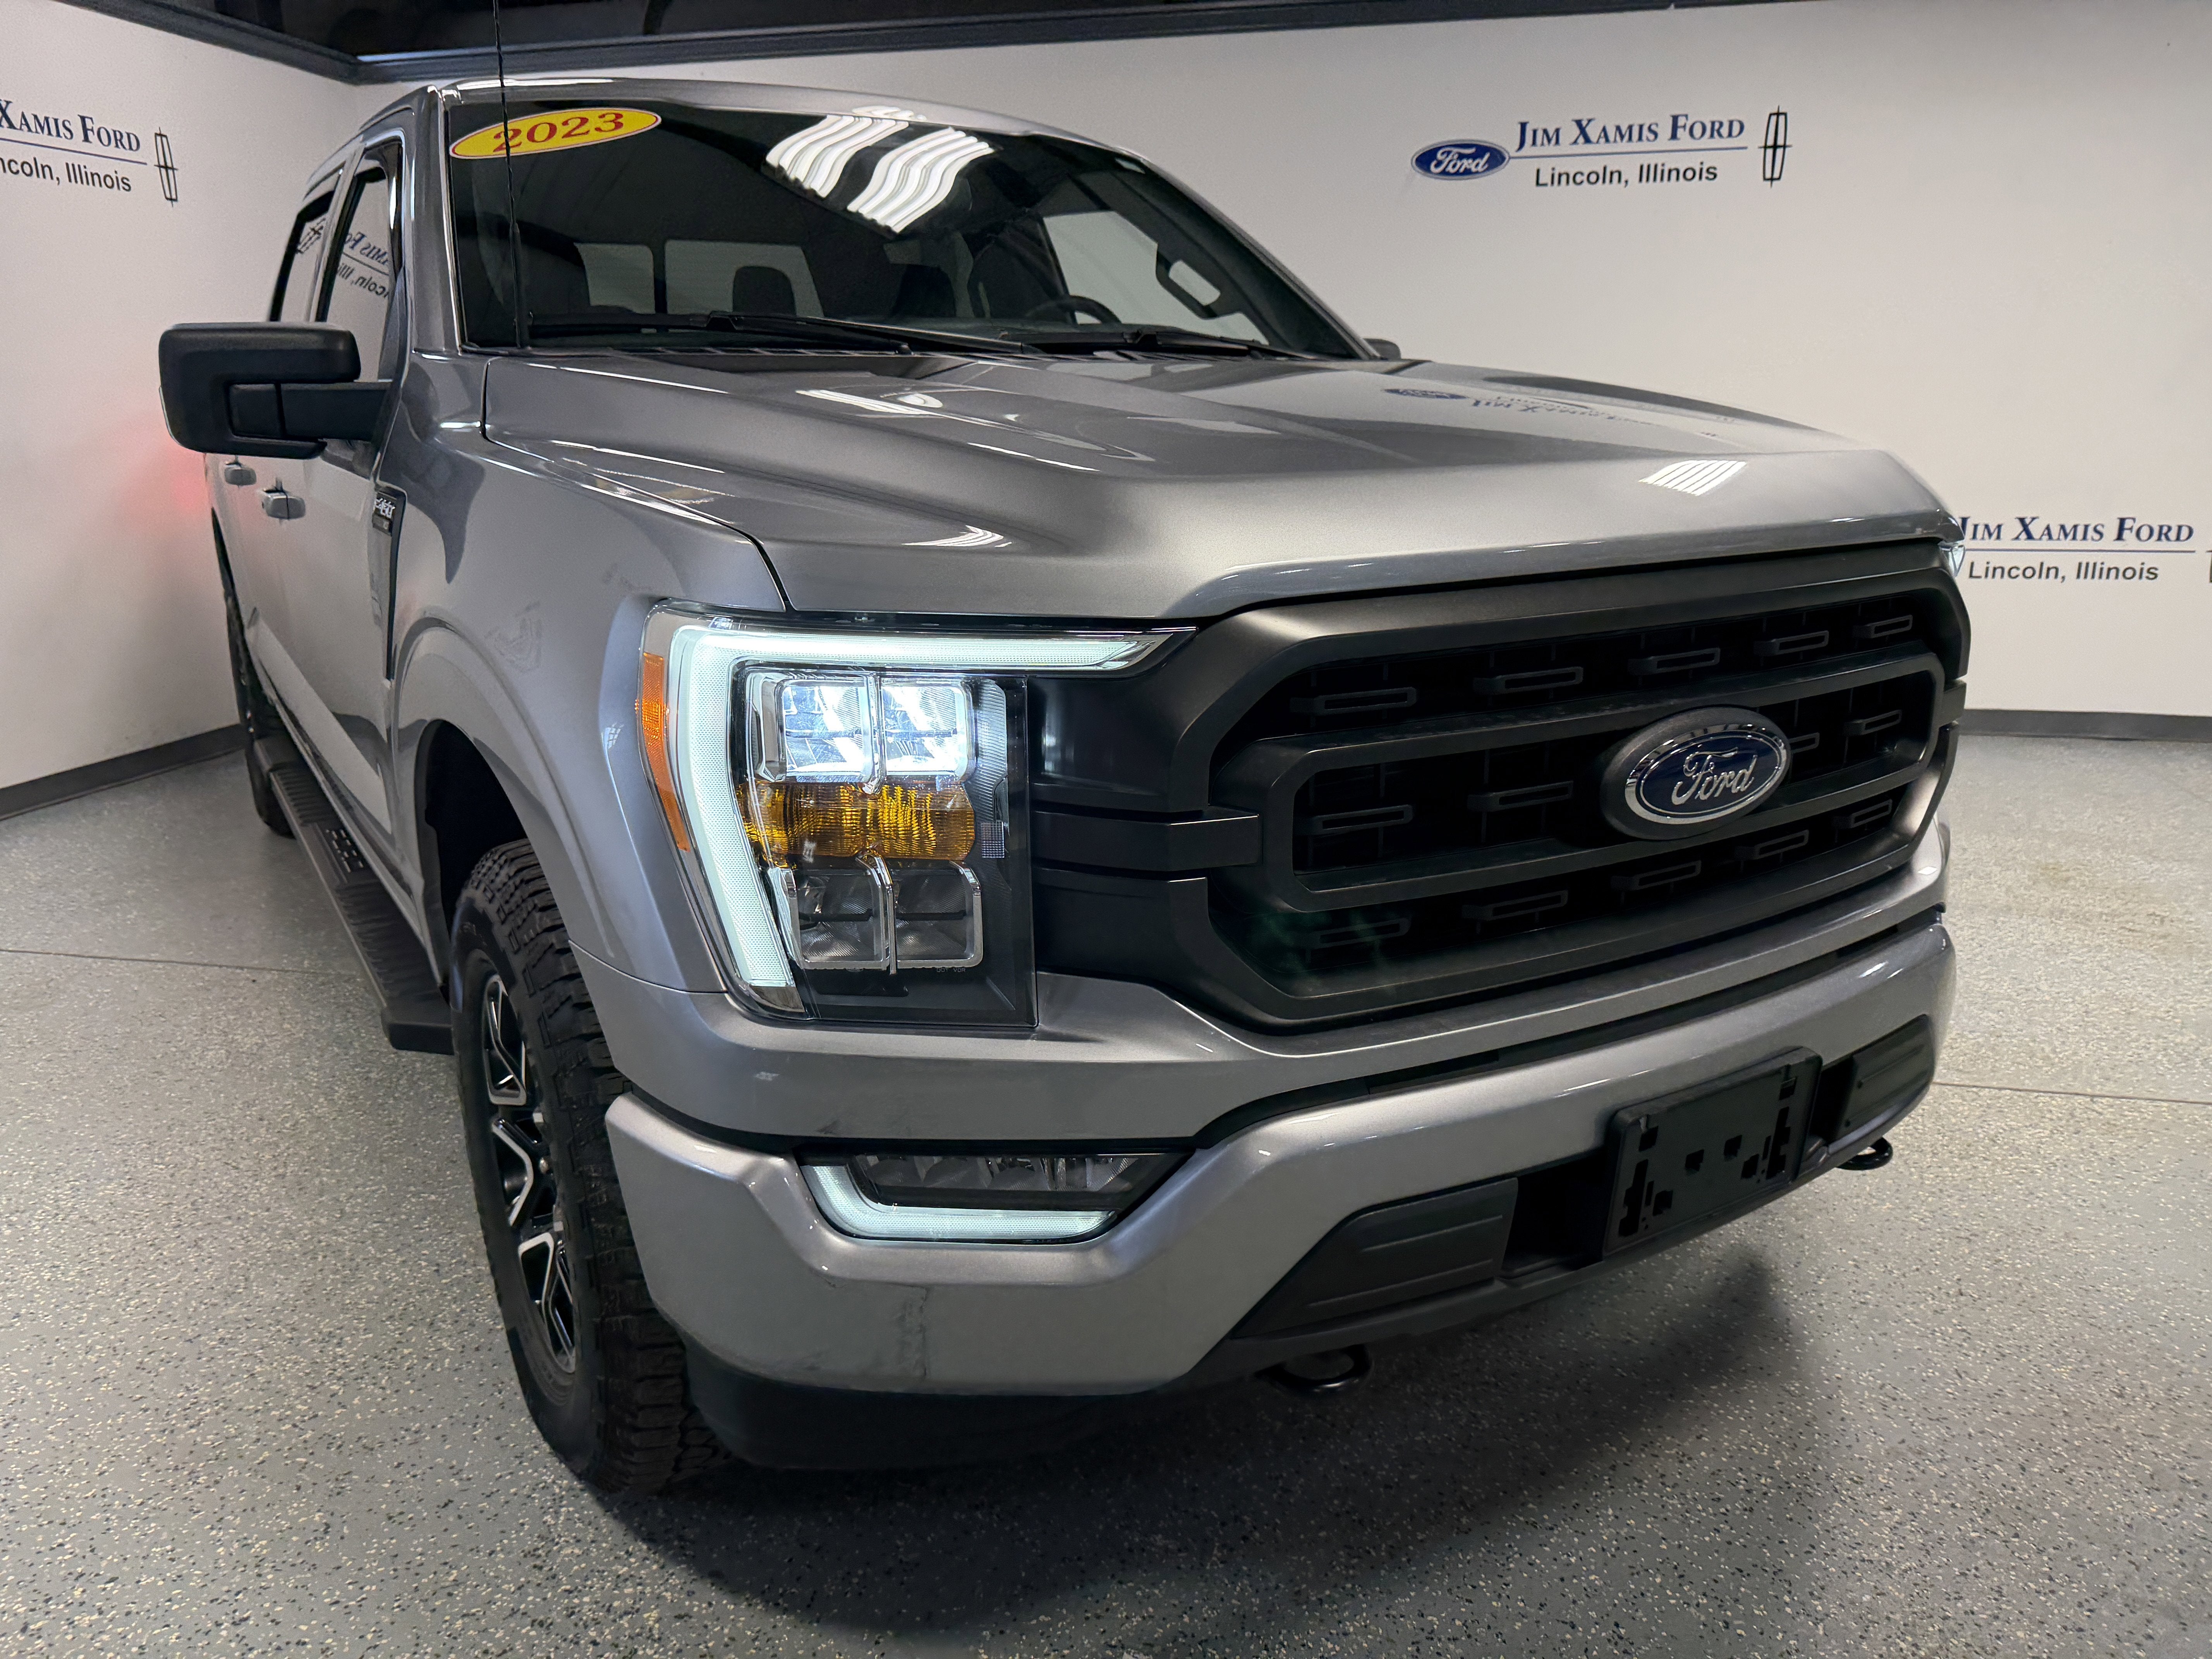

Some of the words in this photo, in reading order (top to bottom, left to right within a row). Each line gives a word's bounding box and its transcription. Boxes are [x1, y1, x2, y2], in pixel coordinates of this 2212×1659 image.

[77, 114, 141, 152] FORD
[492, 112, 623, 153] 2023
[1515, 121, 1561, 152] JIM
[1570, 118, 1659, 145] XAMIS
[1668, 113, 1745, 141] FORD
[1430, 146, 1491, 174] Ford
[1535, 165, 1629, 188] Lincoln,
[1638, 162, 1718, 184] Illinois
[65, 162, 132, 192] Illinois
[2011, 516, 2105, 541] XAMIS
[2113, 517, 2194, 543] FORD
[1968, 562, 2066, 584] Lincoln,
[2075, 562, 2159, 581] Illinois
[1671, 747, 1759, 805] Ford
